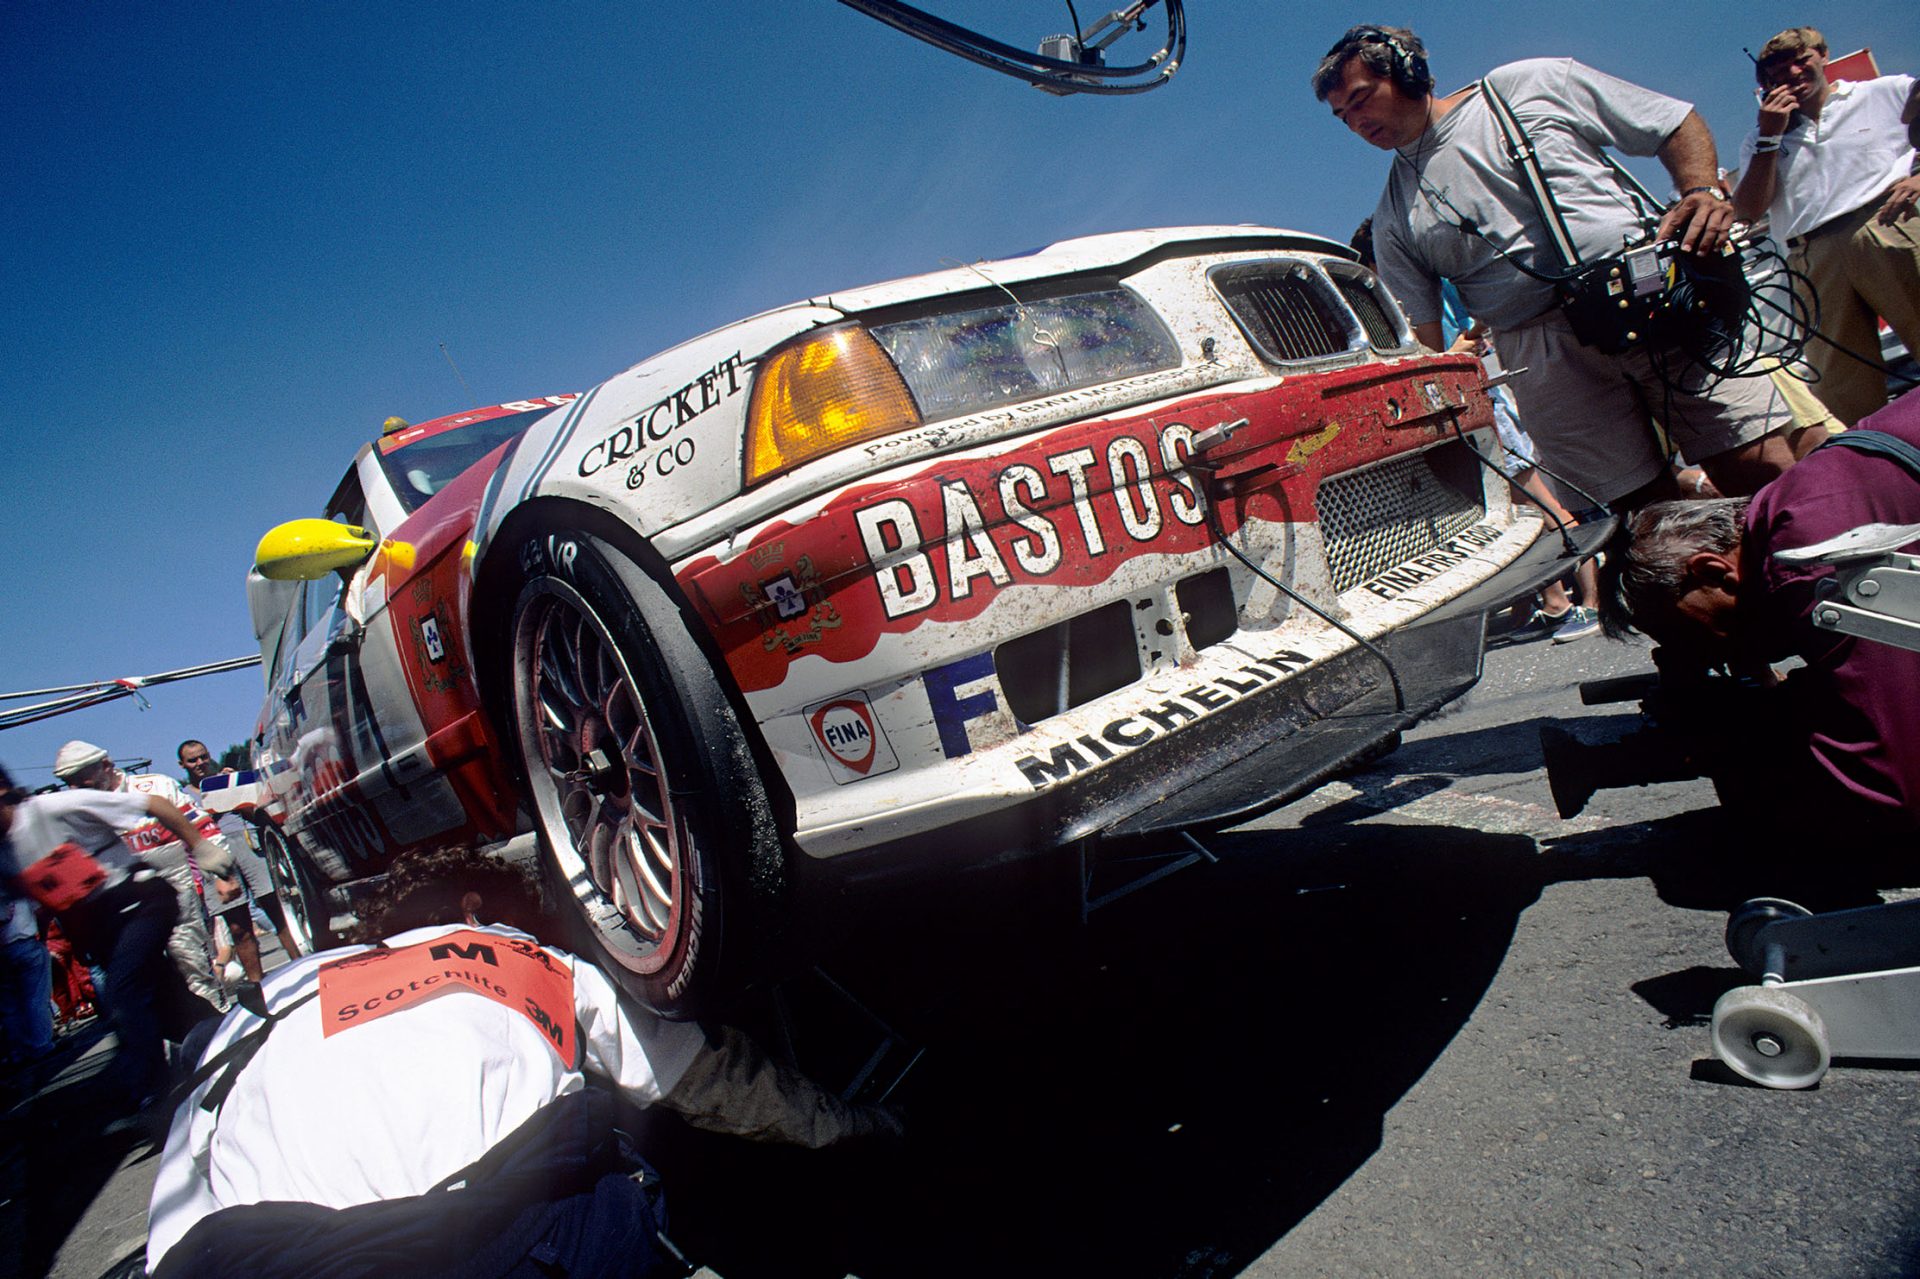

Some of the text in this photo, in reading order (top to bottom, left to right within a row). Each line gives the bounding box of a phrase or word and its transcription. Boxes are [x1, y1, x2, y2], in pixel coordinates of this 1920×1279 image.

[577, 350, 744, 478] CRICKET
[864, 361, 1228, 456] Powered by BMW MOTORSPORT
[626, 437, 696, 491] & CO
[854, 422, 1208, 621] BASTOS
[1363, 565, 1432, 601] FINA
[1412, 541, 1476, 573] FIRST
[825, 718, 870, 748] FINA
[921, 650, 999, 760] F
[1014, 649, 1313, 791] MICHELIN
[667, 891, 703, 1001] MICHELIN
[338, 969, 508, 1022] Scotchlite
[524, 997, 564, 1049] 3M
